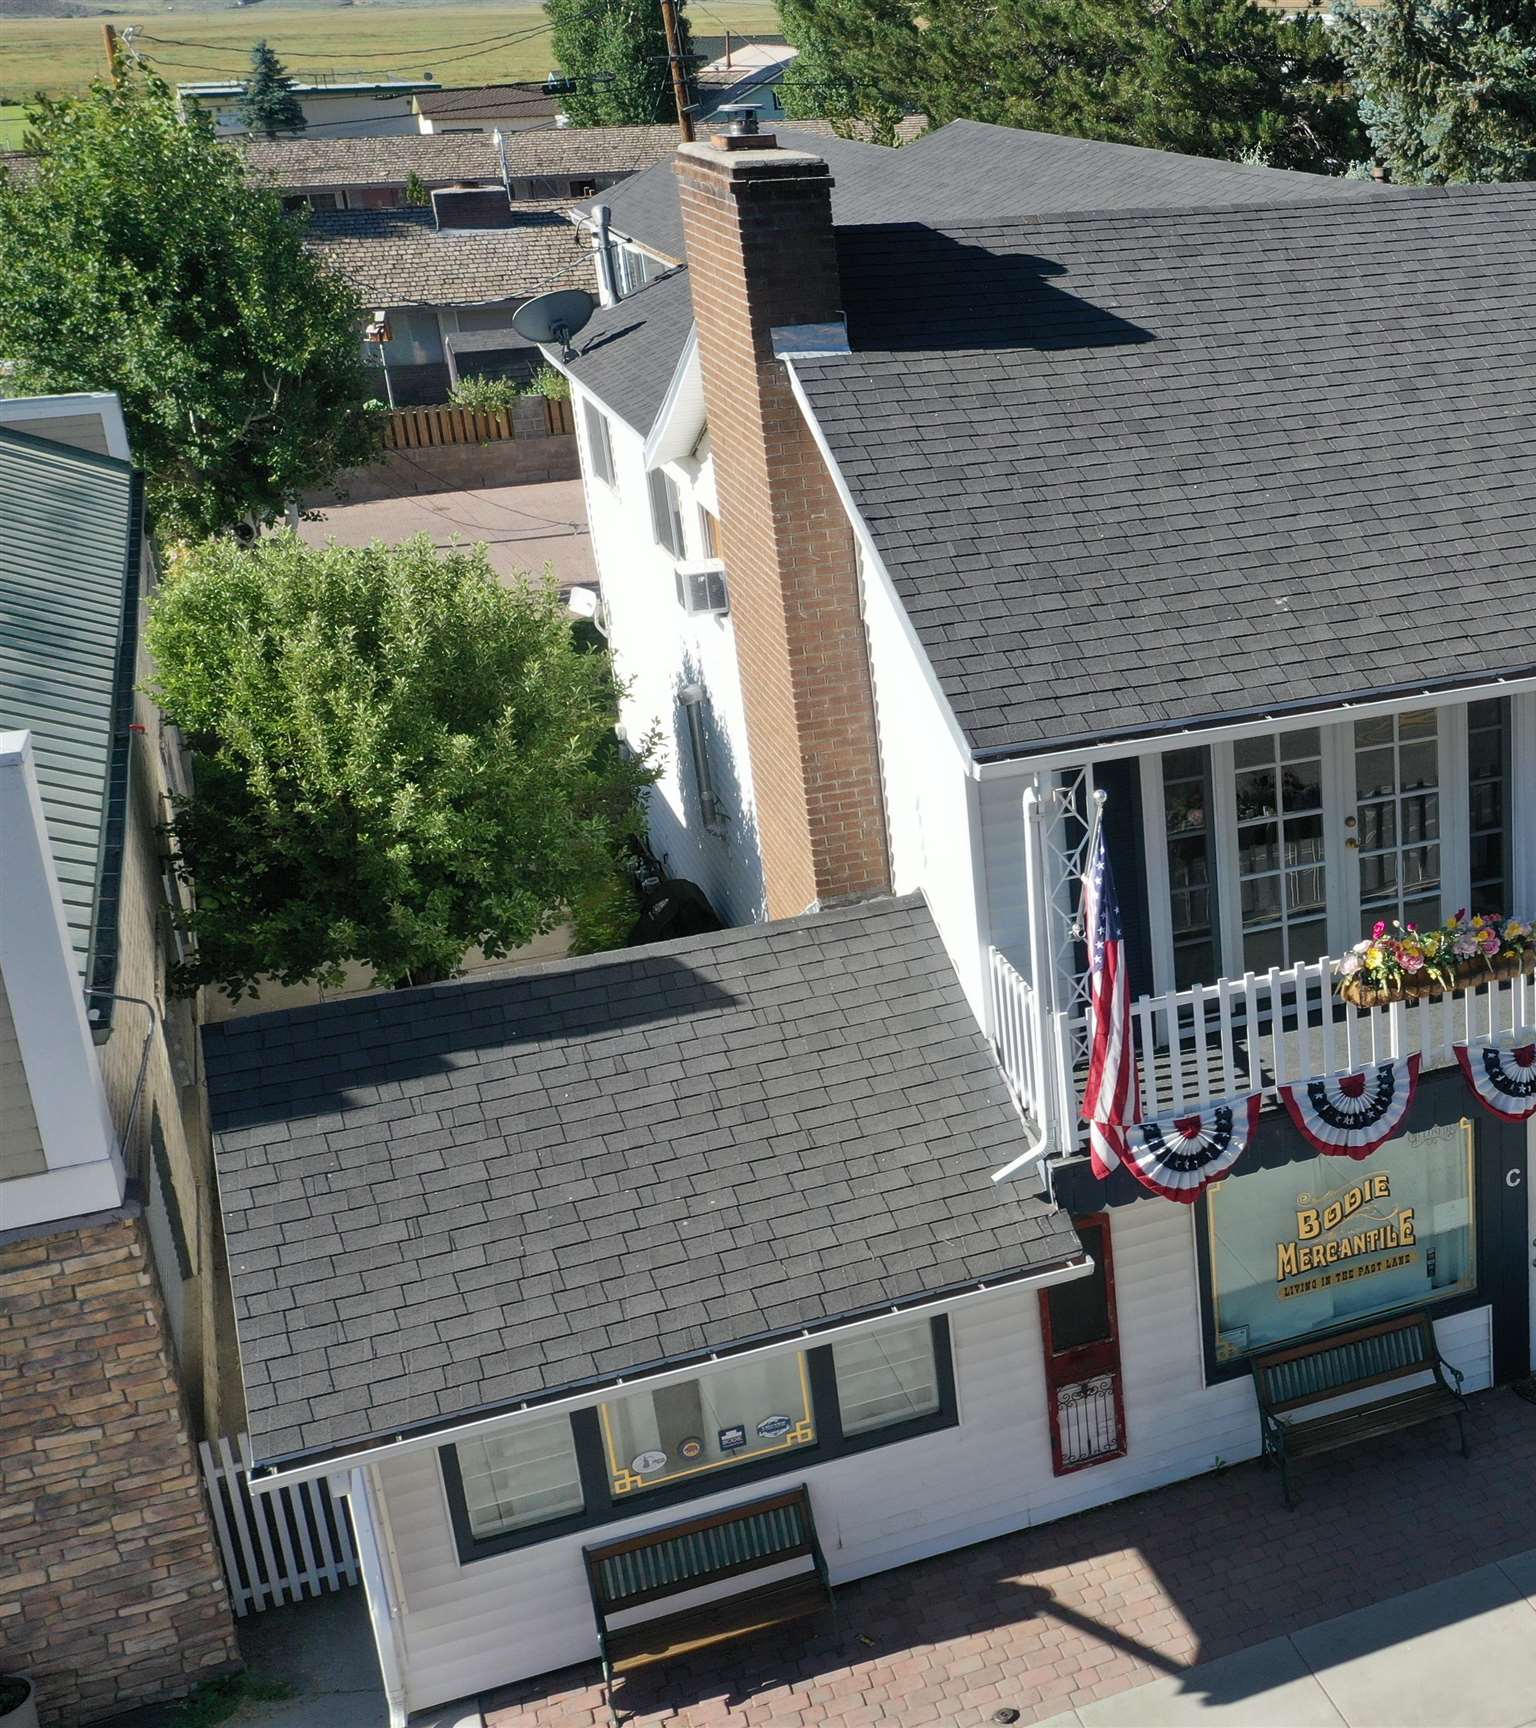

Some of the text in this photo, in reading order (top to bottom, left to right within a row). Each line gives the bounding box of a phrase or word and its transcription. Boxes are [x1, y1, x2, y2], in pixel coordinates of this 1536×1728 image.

[1505, 1168, 1521, 1187] C
[1297, 1175, 1391, 1241] BODIE
[1277, 1208, 1417, 1283] MERCANTILE
[1283, 1279, 1318, 1298] LIVING
[1321, 1276, 1332, 1287] IN
[1336, 1268, 1354, 1283] THE
[1358, 1261, 1382, 1277] PAST
[1386, 1253, 1411, 1269] LANE
